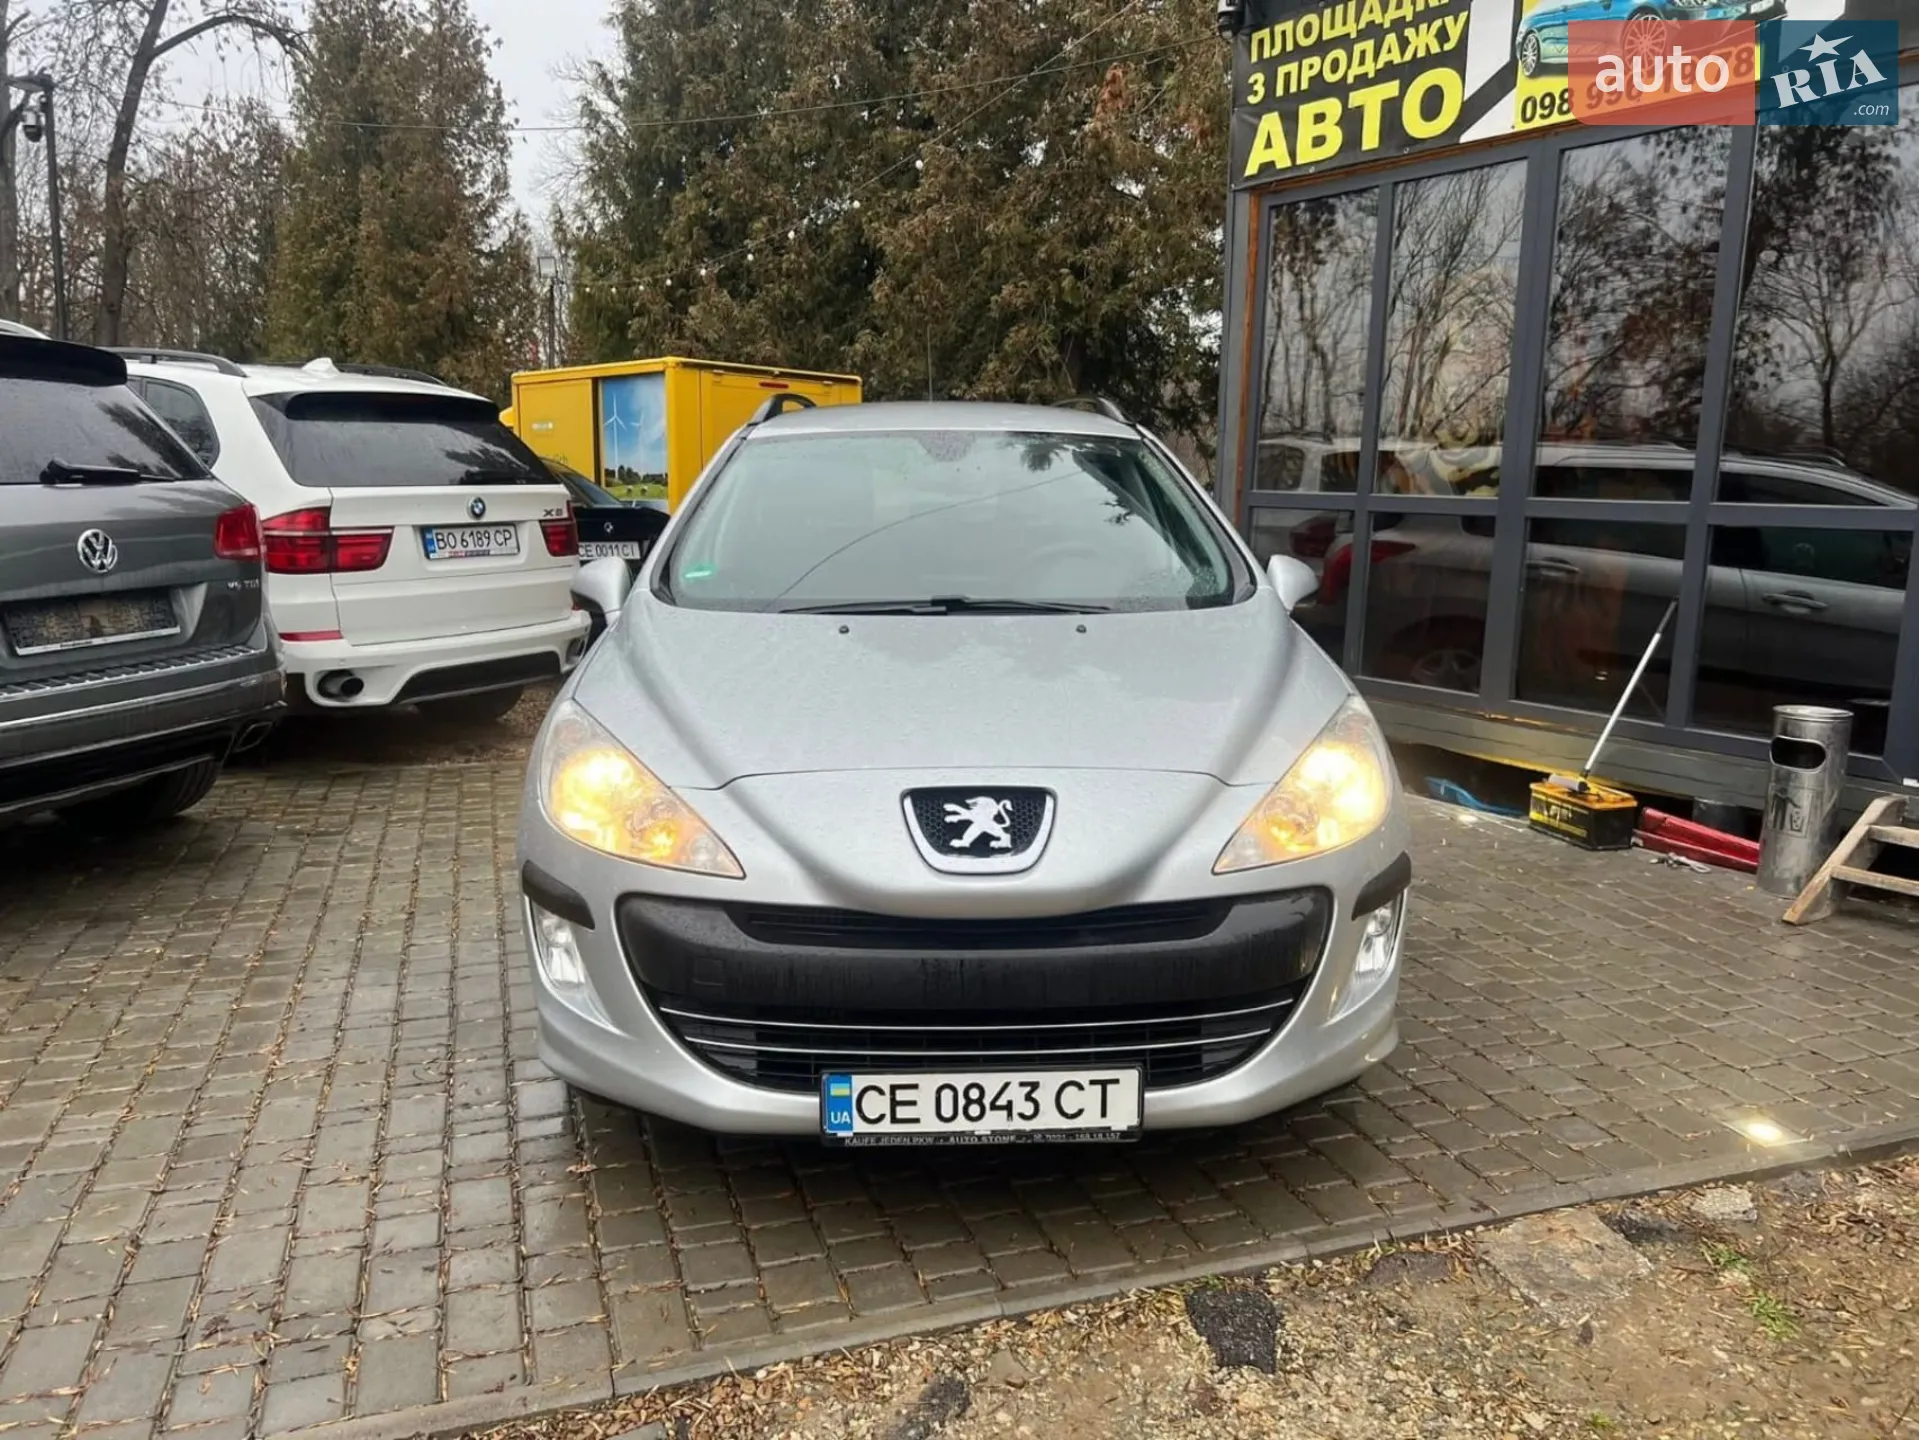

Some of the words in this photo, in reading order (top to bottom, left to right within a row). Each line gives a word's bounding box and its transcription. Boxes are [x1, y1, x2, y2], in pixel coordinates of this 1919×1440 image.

[1251, 0, 1450, 63] ПЛОЩАД
[1276, 10, 1468, 97] ПРОДАЖУ
[1244, 67, 1463, 177] АВТО
[1521, 87, 1575, 125] 098
[435, 532, 457, 549] BO
[461, 530, 491, 548] 6189
[494, 528, 512, 546] CP
[830, 1111, 851, 1124] UA
[855, 1083, 921, 1125] CE
[935, 1080, 1040, 1123] 0843
[1054, 1078, 1120, 1121] CT
